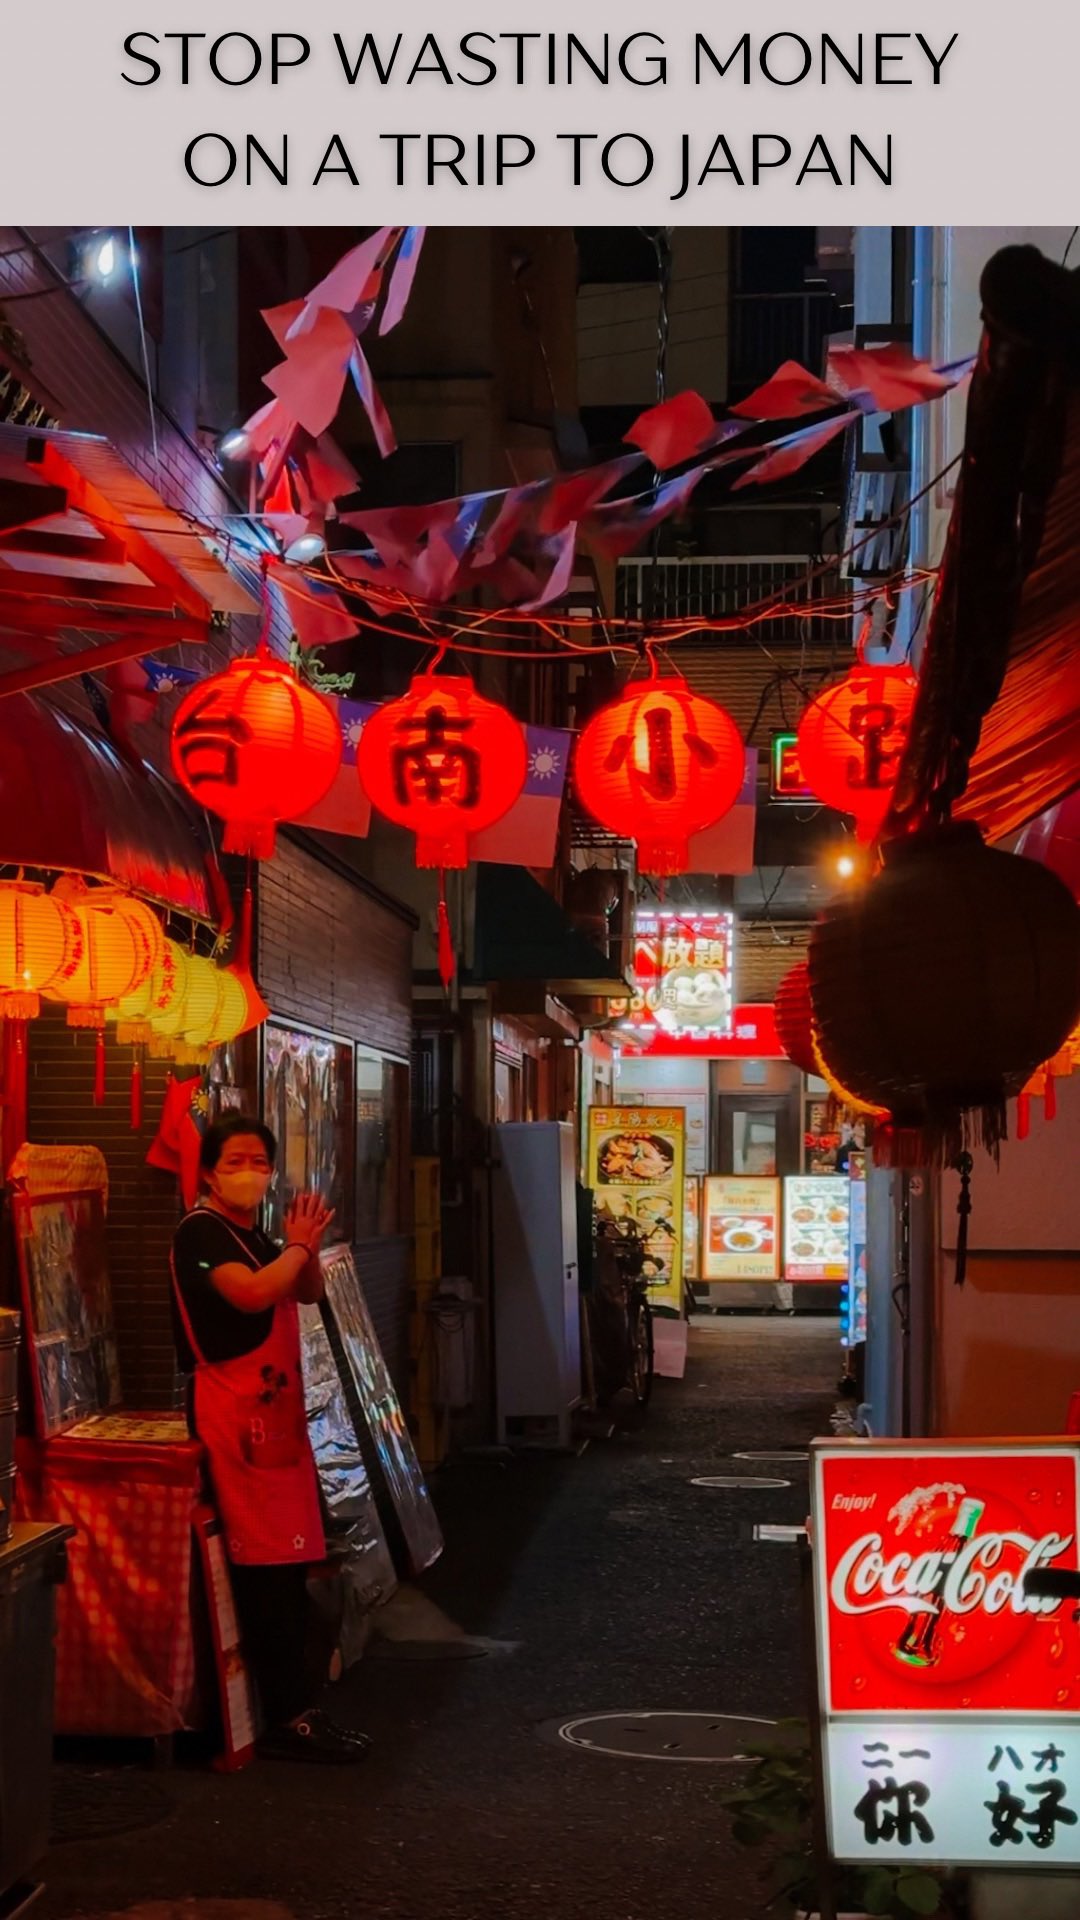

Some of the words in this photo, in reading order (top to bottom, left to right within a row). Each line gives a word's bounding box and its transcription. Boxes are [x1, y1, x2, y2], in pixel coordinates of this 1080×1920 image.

[176, 689, 253, 786] 台
[391, 705, 481, 808] 南
[603, 706, 719, 802] 小
[831, 1493, 877, 1513] Enjoy!
